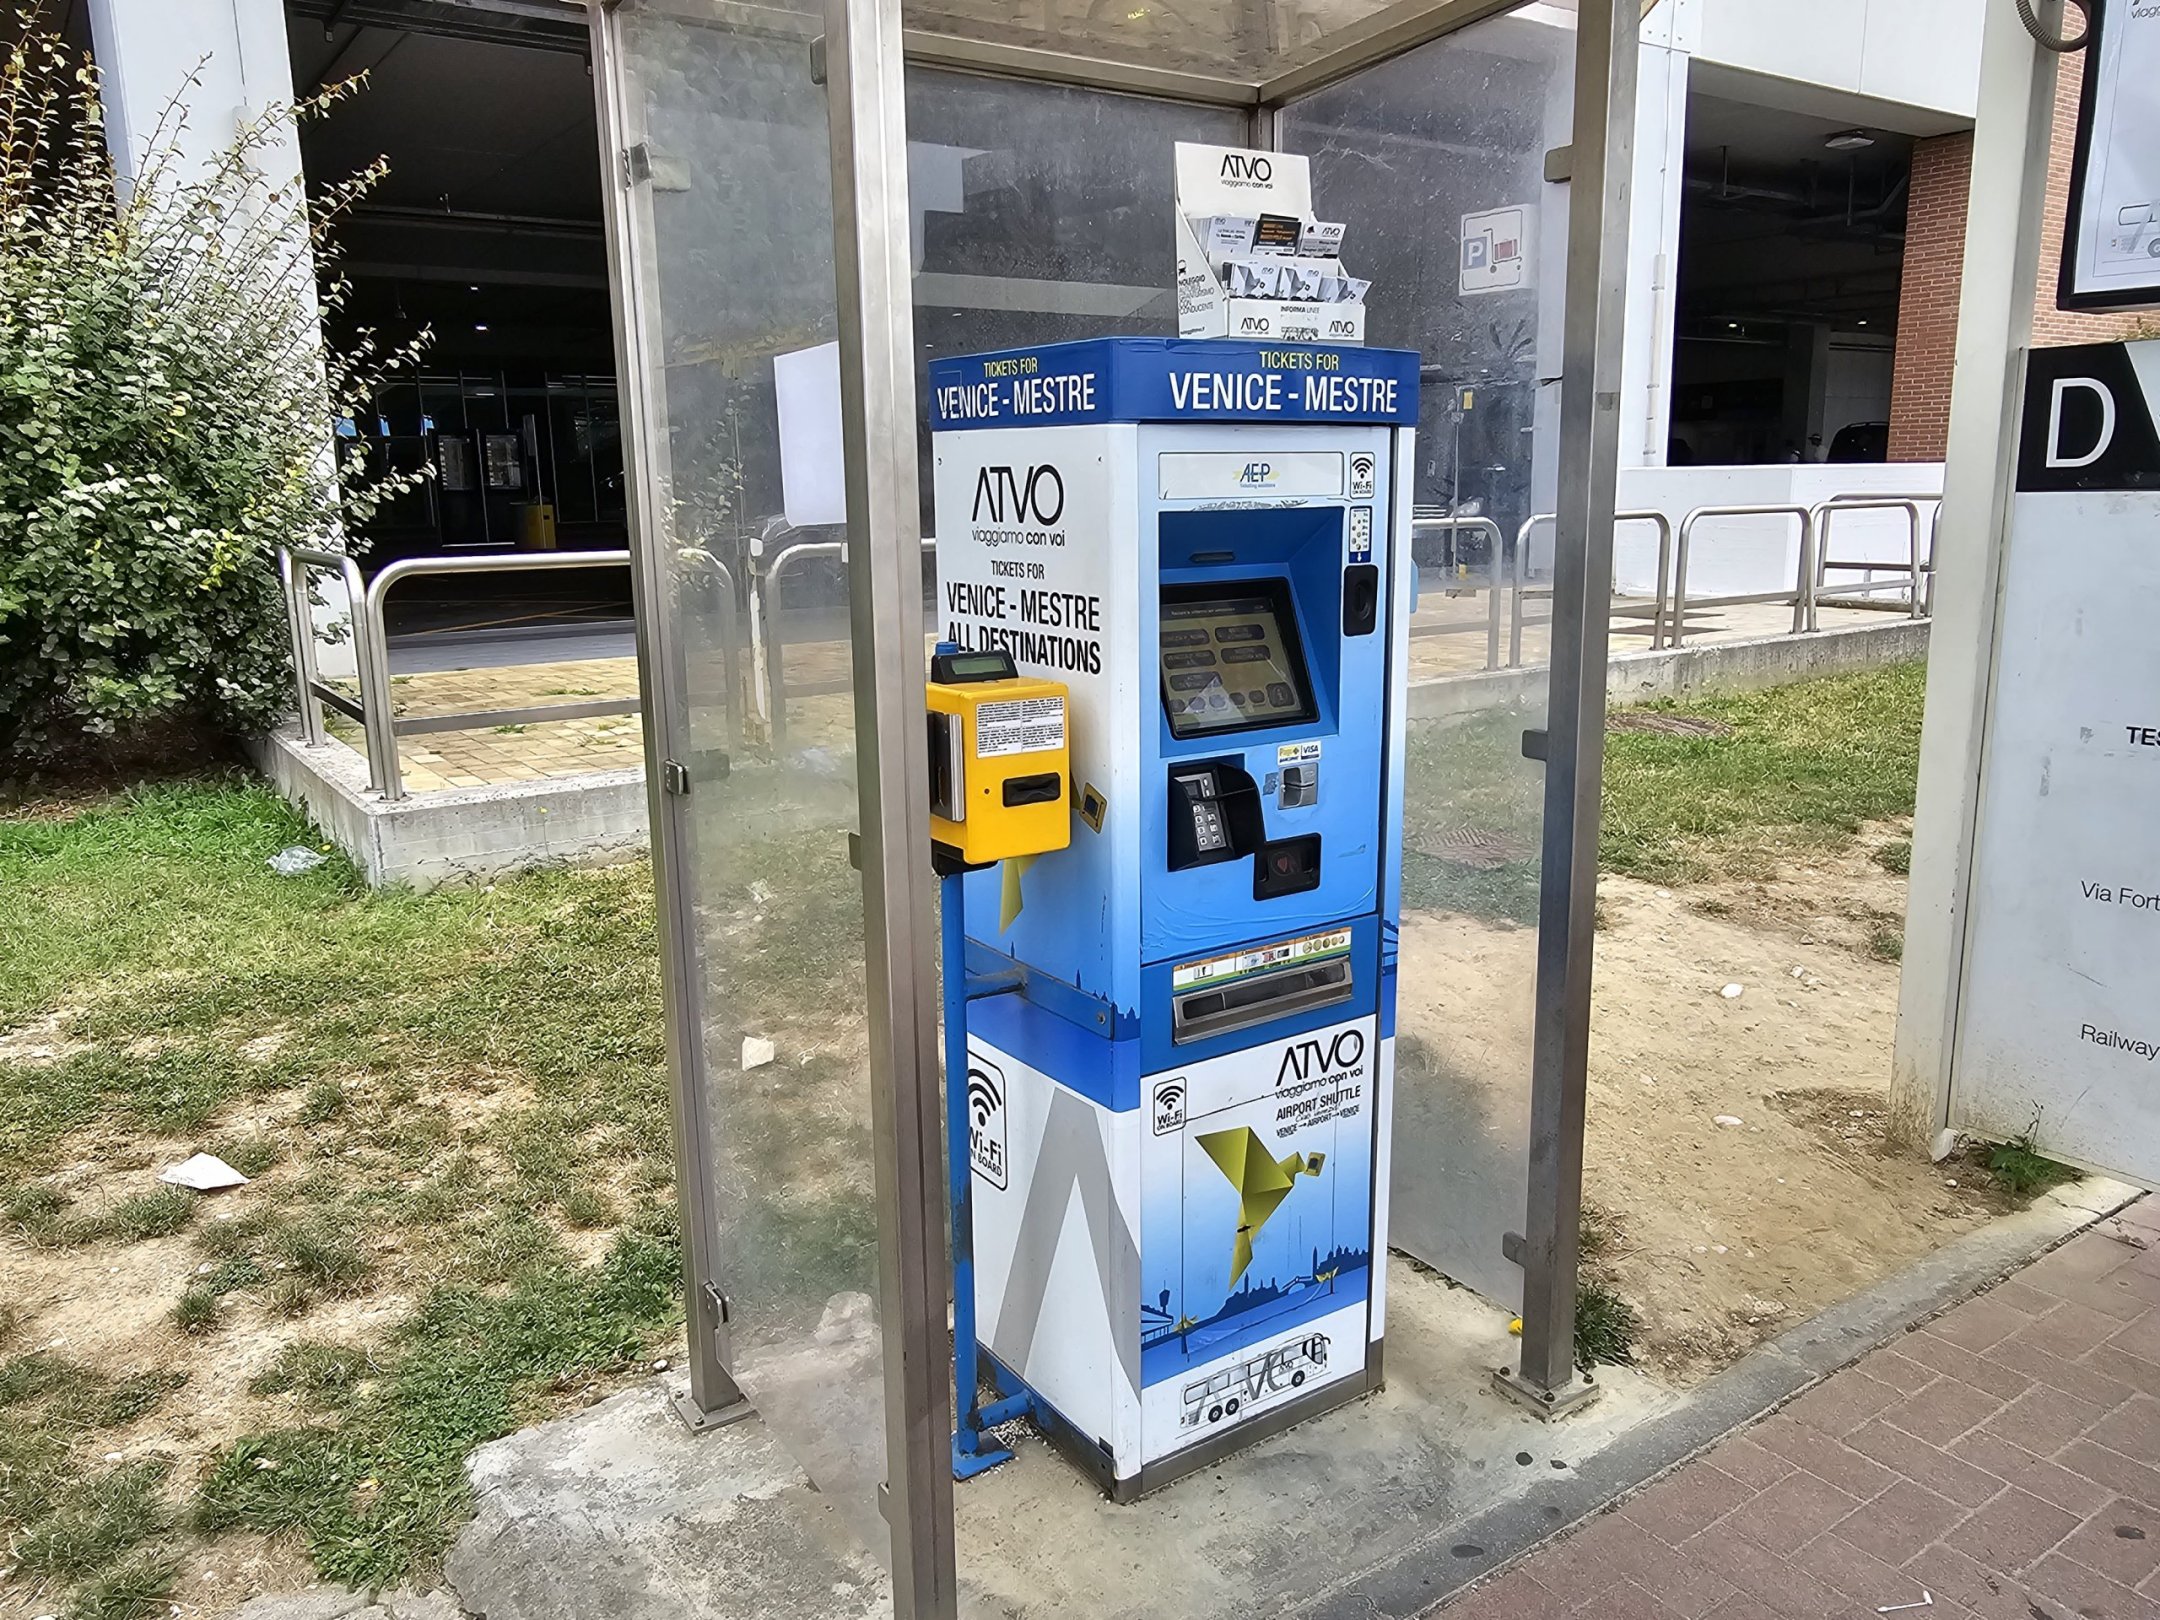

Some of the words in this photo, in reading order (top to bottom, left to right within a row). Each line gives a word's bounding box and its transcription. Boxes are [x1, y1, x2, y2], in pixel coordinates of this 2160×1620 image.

[1221, 154, 1272, 182] ATVO
[1221, 179, 1251, 188] viaggiamo
[1468, 241, 1484, 266] P
[1241, 318, 1270, 331] ATVO
[1329, 321, 1355, 334] ATVO
[984, 359, 1018, 378] TICKETS
[1020, 357, 1038, 374] FOR
[1259, 351, 1313, 369] TICKETS
[1316, 354, 1339, 371] FOR
[937, 382, 999, 420] VENICE
[1013, 373, 1096, 415] MESTRE
[1169, 372, 1282, 411] VENICE
[1304, 375, 1398, 413] MESTRE
[2045, 377, 2116, 468] D
[1240, 463, 1271, 482] AEP
[971, 464, 1064, 526] ATVO
[1353, 481, 1372, 490] Wi-Fi
[972, 526, 1024, 547] viaggiamo
[1026, 532, 1047, 546] con
[1050, 530, 1065, 547] voi
[991, 560, 1025, 579] TICKETS
[1027, 563, 1045, 580] FOR
[947, 581, 1006, 619] VENICE
[1021, 589, 1100, 632] MESTRE
[948, 621, 975, 652] ALL
[979, 625, 1101, 675] DESTINATIONS
[1304, 744, 1319, 754] VISA
[2081, 880, 2112, 903] Via
[2080, 1023, 2160, 1061] Railway
[1275, 1029, 1364, 1087] ATVO
[1275, 1078, 1327, 1099] viaggiamo
[1328, 1072, 1347, 1085] con
[1349, 1065, 1364, 1078] voi
[1276, 1097, 1318, 1121] AIRPORT
[1319, 1085, 1361, 1108] SHUTTLE
[1157, 1109, 1183, 1125] Wi-Fi
[1276, 1122, 1298, 1137] VENICE
[1307, 1113, 1332, 1127] AIRPORT
[1340, 1104, 1360, 1117] VENICE
[978, 1152, 1002, 1177] BOARD
